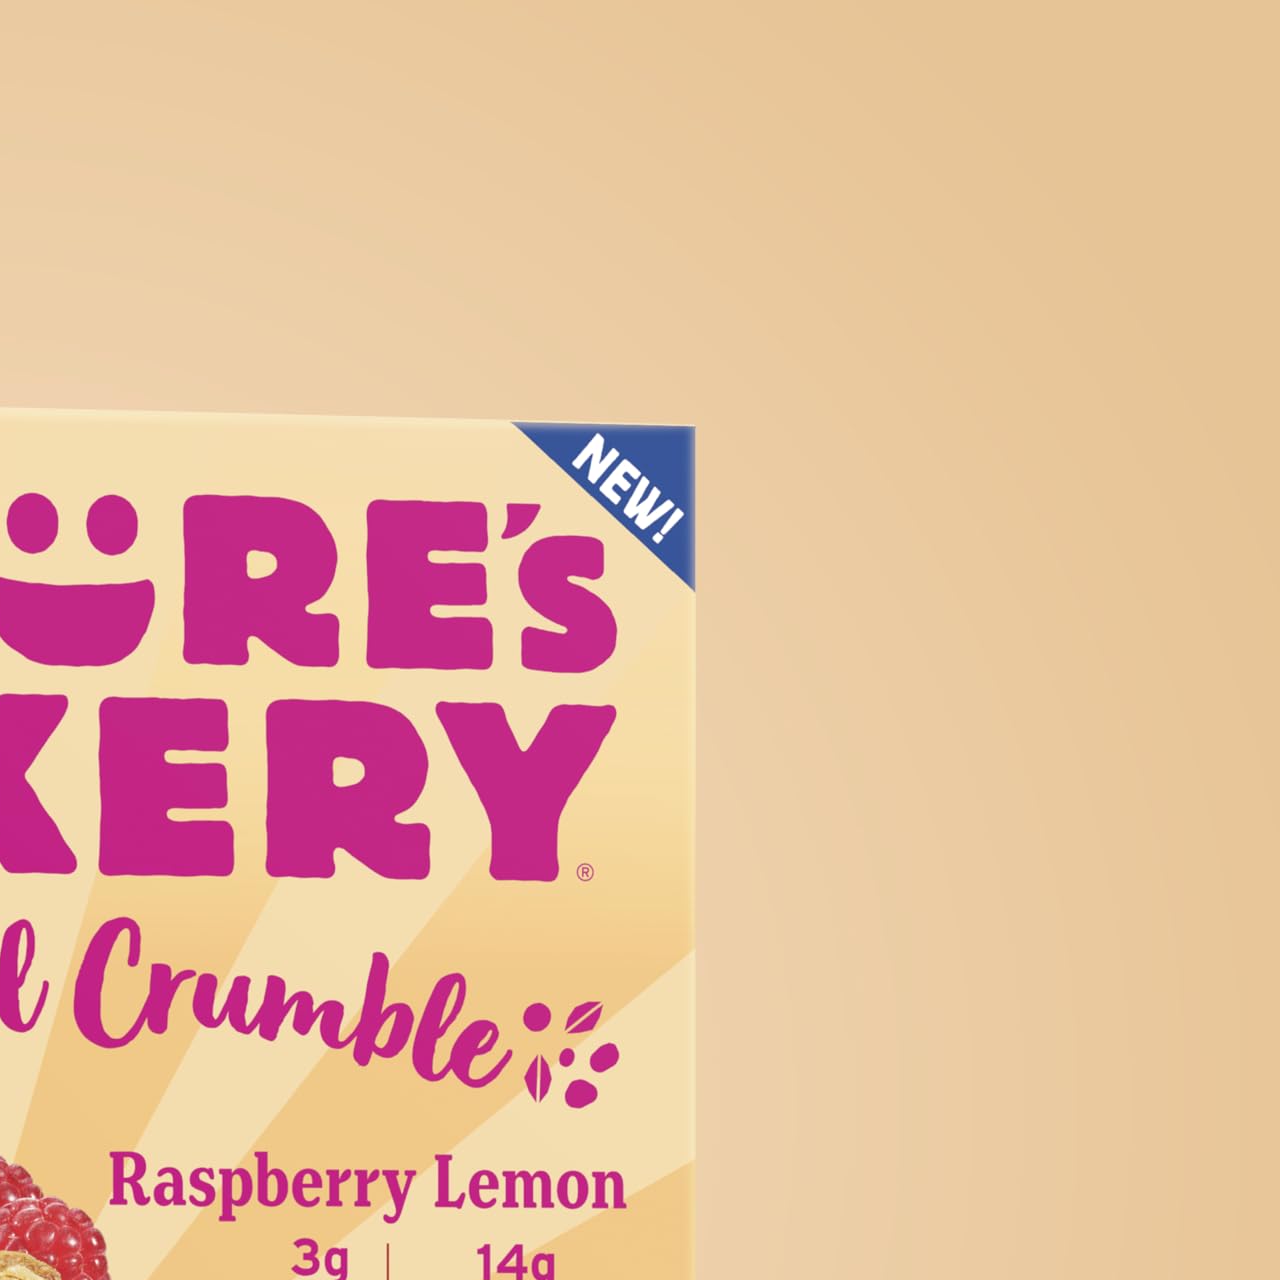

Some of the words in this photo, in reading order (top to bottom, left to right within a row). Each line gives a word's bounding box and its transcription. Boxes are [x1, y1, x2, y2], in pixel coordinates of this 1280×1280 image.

[572, 433, 684, 544] NEW!
[73, 917, 513, 1089] Crumble
[109, 1151, 417, 1224] Raspberry
[434, 1154, 626, 1210] Lemon
